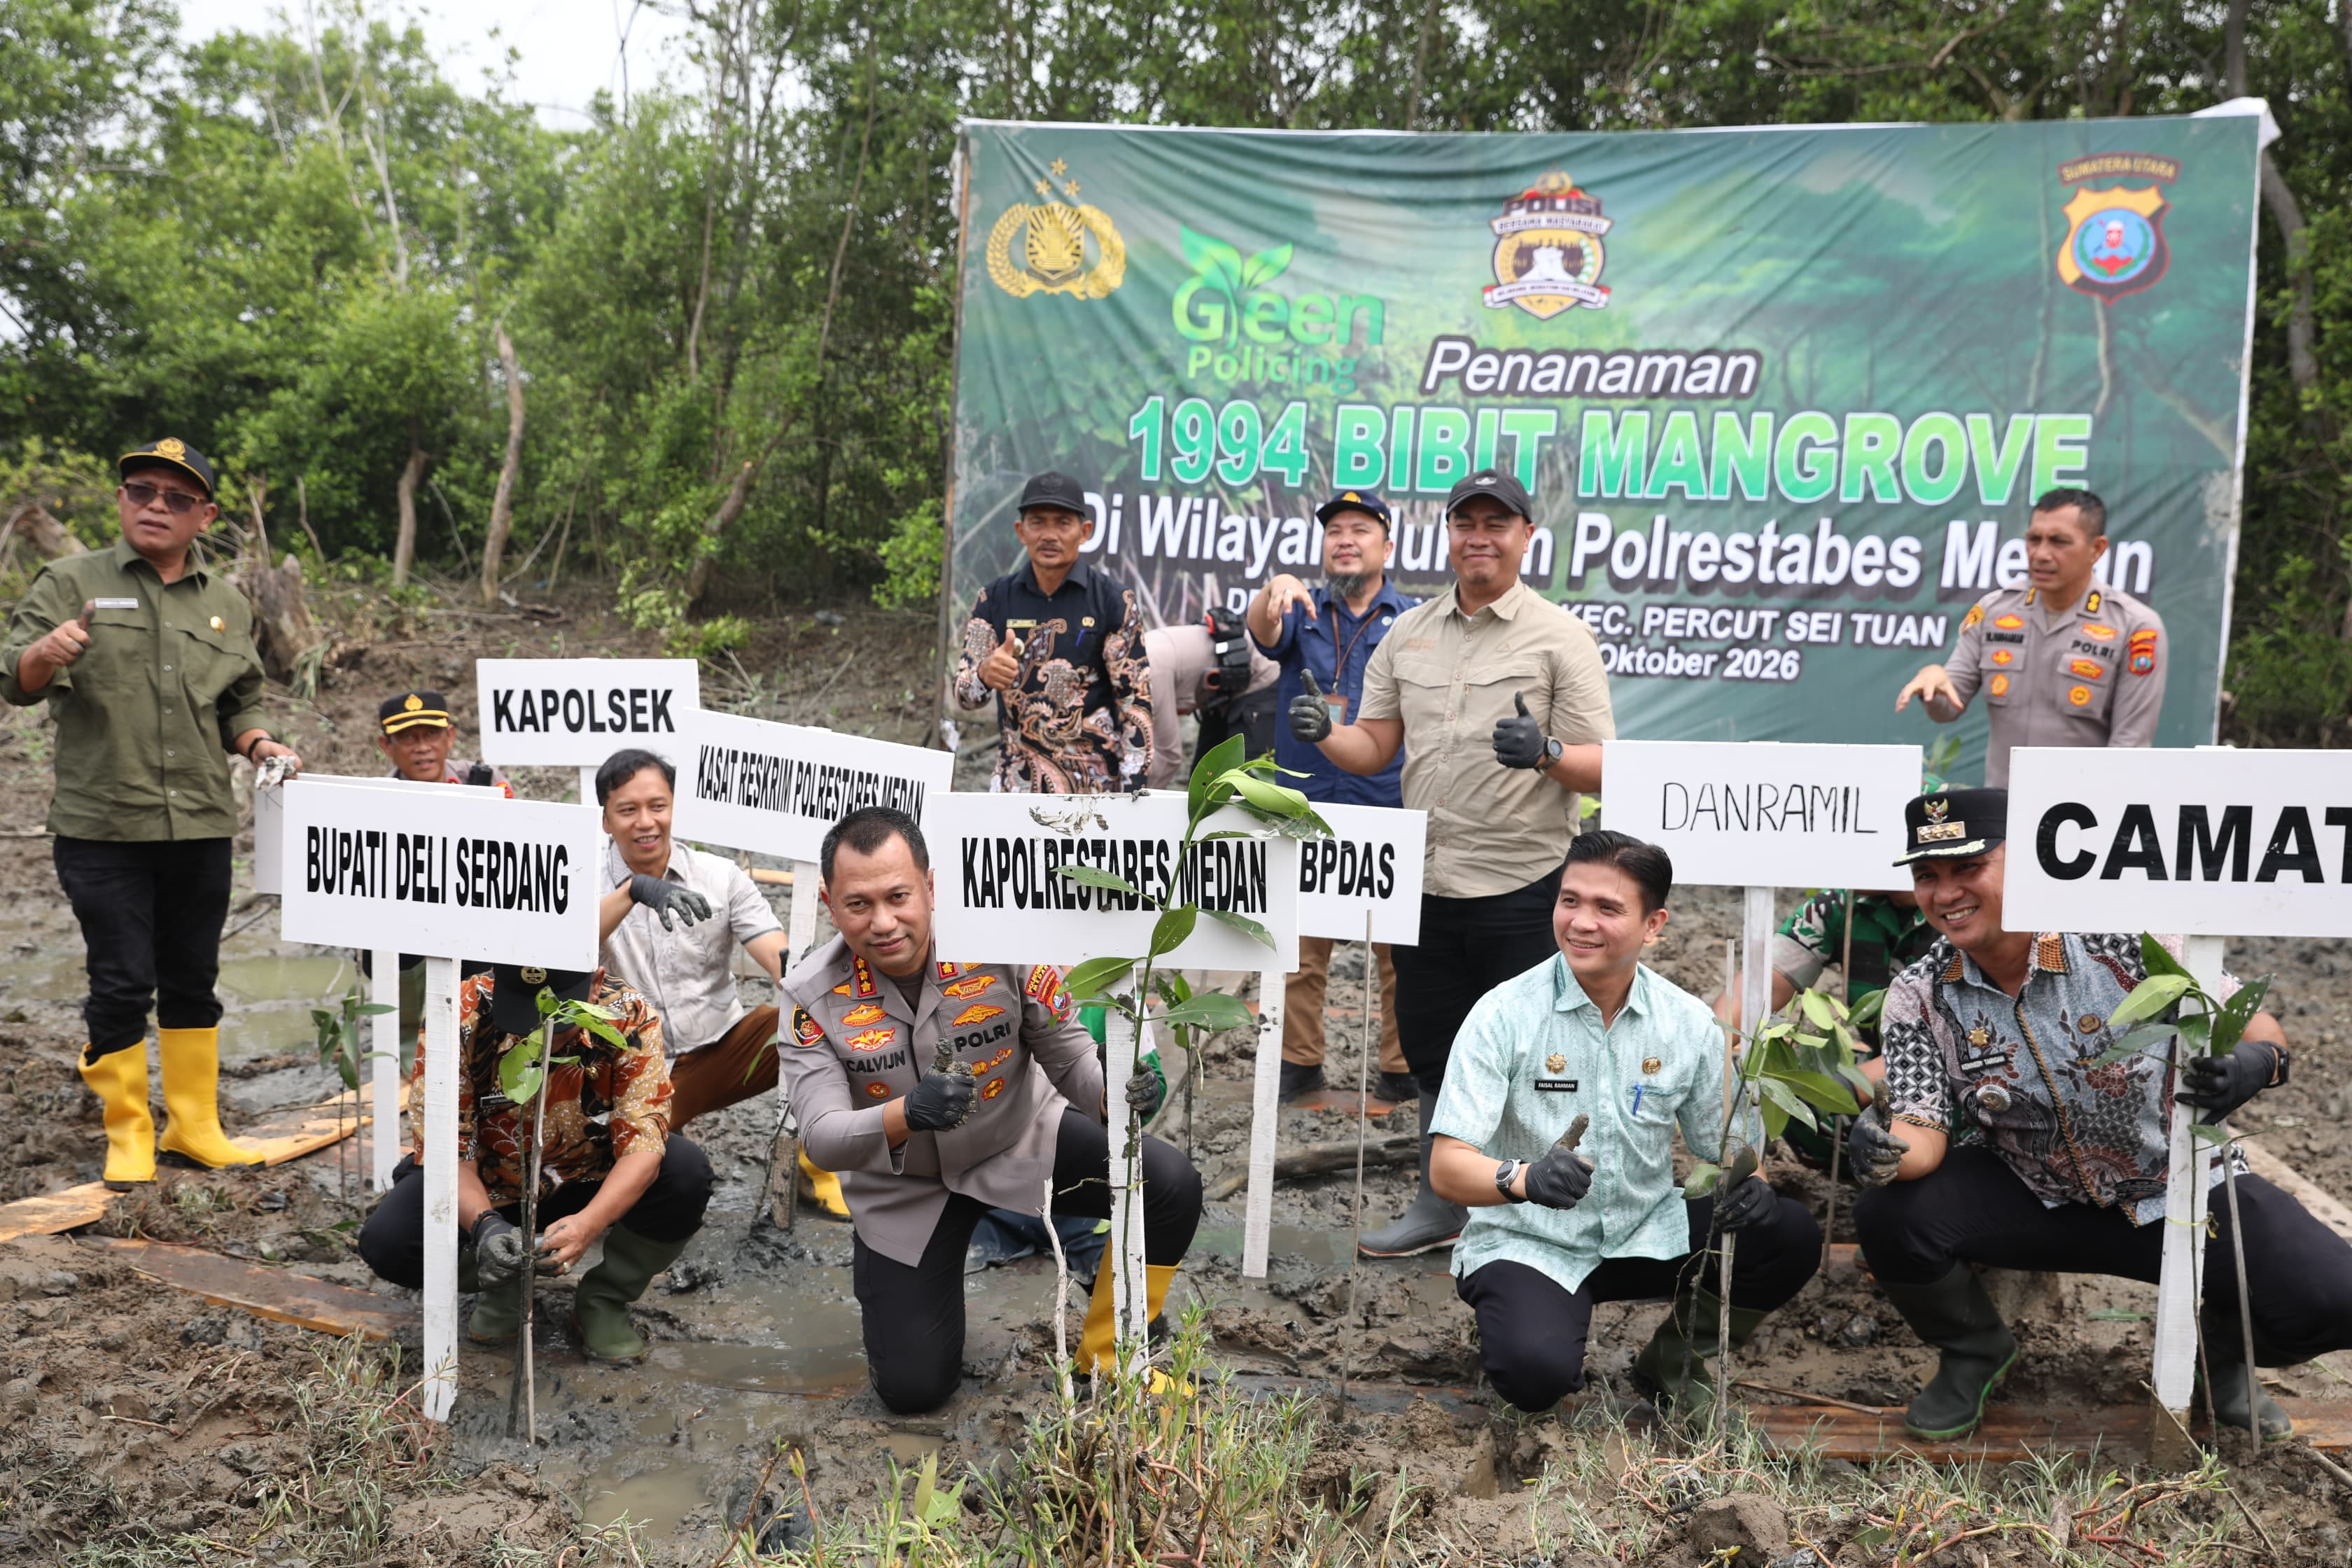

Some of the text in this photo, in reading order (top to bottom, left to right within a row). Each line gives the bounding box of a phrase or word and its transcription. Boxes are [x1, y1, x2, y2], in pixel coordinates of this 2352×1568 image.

[1187, 344, 1358, 395] Policing
[1424, 341, 1757, 394] Penanaman
[1129, 396, 2092, 505] 1994 BIBIT MANGROVE
[1571, 512, 1922, 588] Polrestabes
[1642, 606, 1781, 641] PERCUT
[1785, 610, 1843, 643] SEI
[1850, 613, 1948, 648] TUAN
[2071, 639, 2115, 659] POLRI
[1599, 642, 1802, 680] Oktober 2026
[494, 690, 675, 733] KAPOLSEK
[696, 744, 925, 828] KASAT RESKRIM POLRESTABES MEDAN
[1662, 782, 1879, 834] DANRAMIL
[307, 826, 568, 915] BUPATI DELI SERDANG
[962, 837, 1267, 913] KAPOLRESTABES MEDAN
[1299, 839, 1395, 899] BPDAS
[845, 1050, 906, 1073] CALVIJN
[953, 1022, 1011, 1052] POLRI
